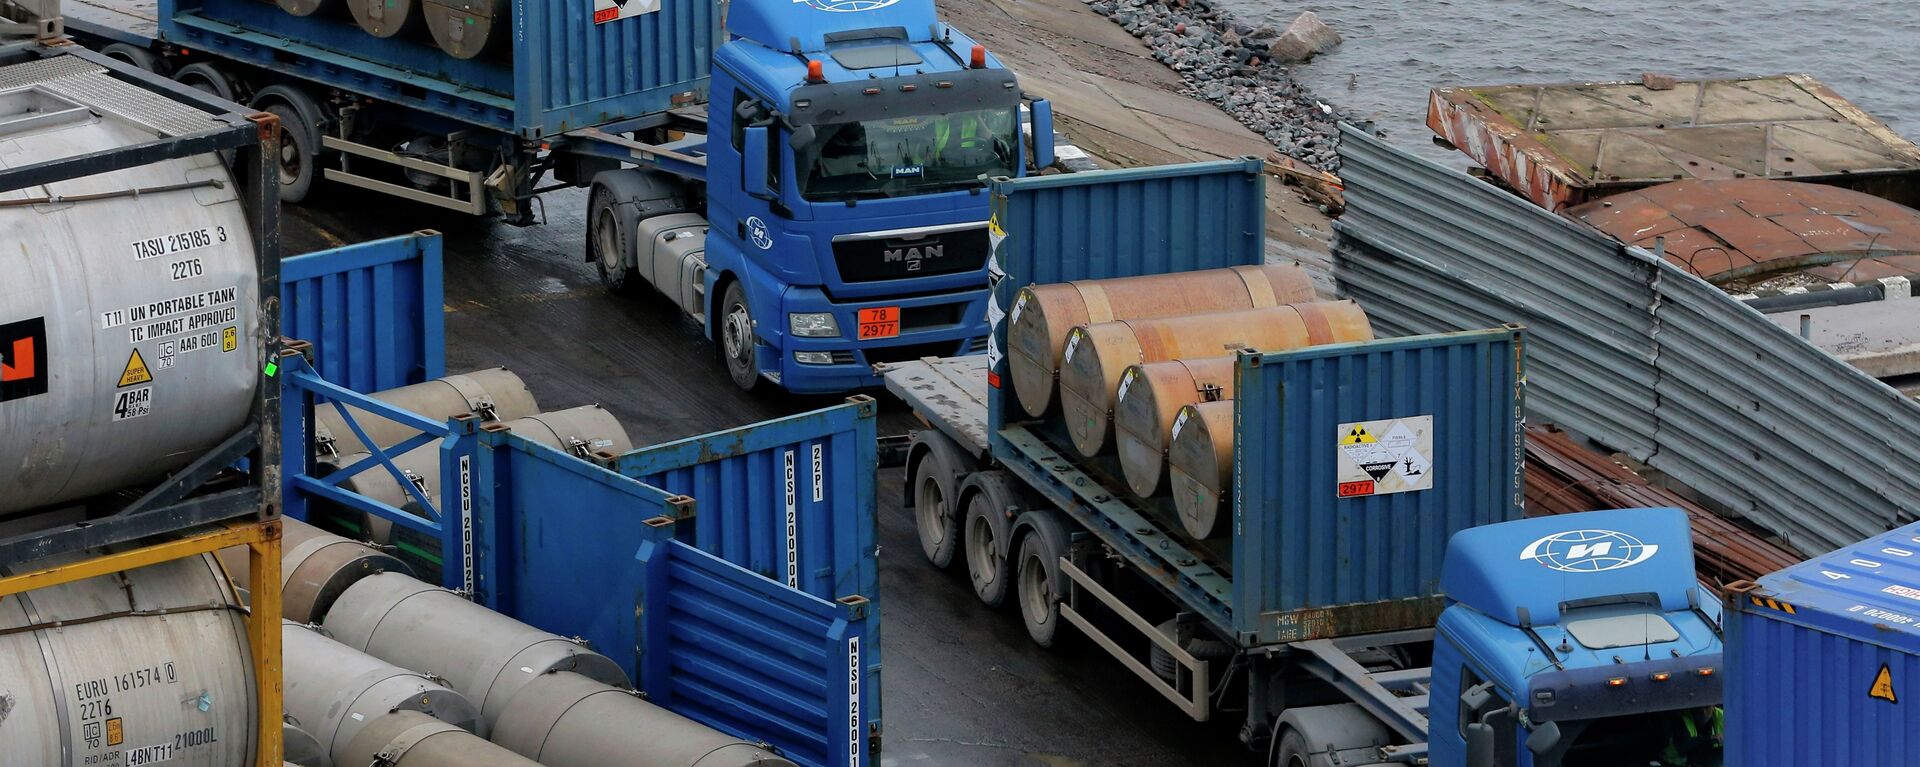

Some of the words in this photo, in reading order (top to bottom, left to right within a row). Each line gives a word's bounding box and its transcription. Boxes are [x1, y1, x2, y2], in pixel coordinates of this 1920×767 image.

[133, 238, 165, 259] TASU
[168, 229, 211, 252] 215185
[217, 226, 227, 242] 3
[884, 245, 943, 262] MAN
[171, 258, 203, 280] 22T6
[130, 305, 145, 321] UN
[149, 294, 205, 318] PORTABLE
[208, 287, 235, 306] TANK
[131, 327, 143, 342] TC
[147, 318, 185, 339] IMPACT
[188, 307, 235, 330] APPROVED
[872, 309, 887, 321] 78
[863, 324, 894, 337] 2977
[180, 337, 198, 352] AAR
[201, 332, 218, 348] 600
[126, 366, 145, 376] SUPER
[161, 358, 171, 367] 70
[126, 374, 144, 383] HEAVY
[115, 393, 128, 418] 4
[129, 388, 149, 404] BAR
[127, 408, 137, 417] 58
[813, 447, 821, 499] 22P1
[1365, 464, 1391, 472] CORROSIVE
[461, 460, 469, 511] NCSU
[786, 454, 794, 506] NCSU
[1343, 483, 1371, 494] 2977
[464, 517, 472, 592] 200022
[788, 512, 796, 589] 200004
[1277, 613, 1299, 626] MGW
[1277, 628, 1297, 640] TARE
[76, 679, 108, 701] EURU
[114, 667, 161, 692] 161574
[167, 663, 175, 680] 0
[81, 699, 112, 721] 22T6
[87, 739, 99, 749] 70
[175, 727, 217, 750] 21000L
[84, 750, 120, 766] RID/ADR
[125, 746, 151, 767] L4BN
[153, 744, 172, 762] T11
